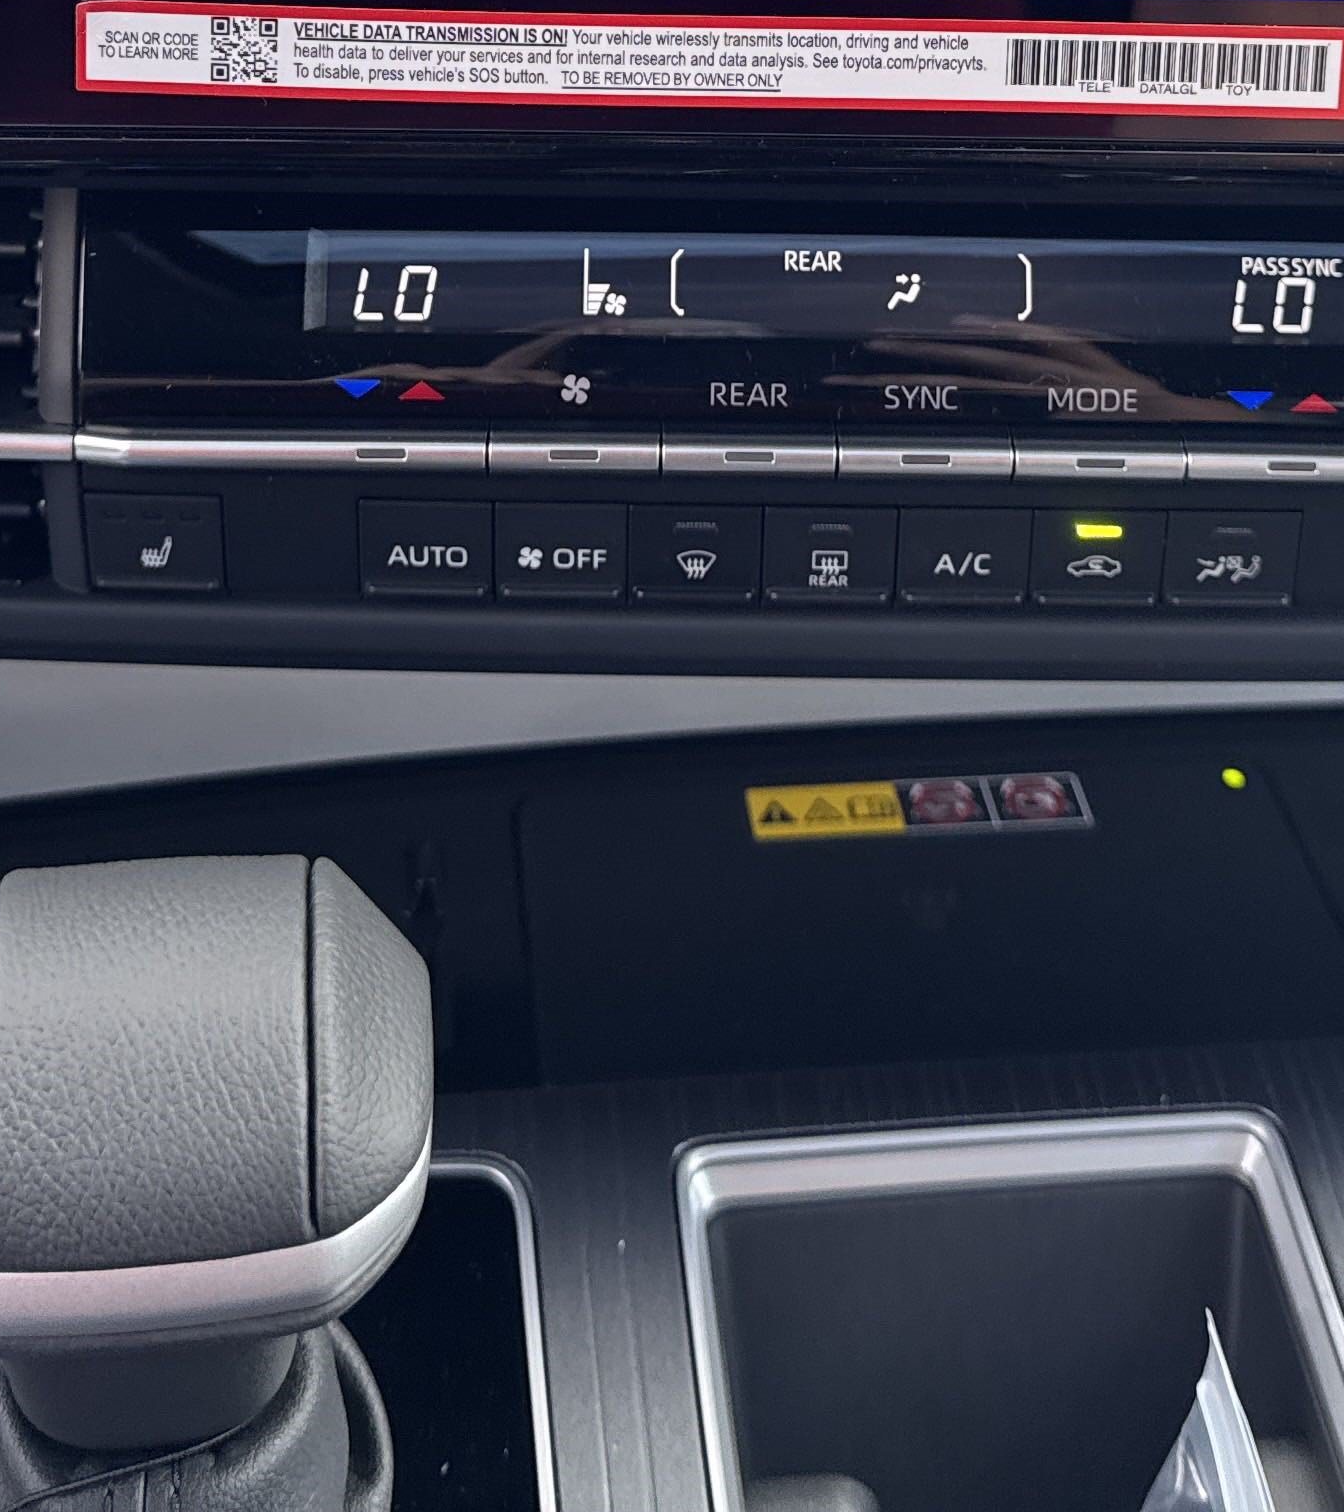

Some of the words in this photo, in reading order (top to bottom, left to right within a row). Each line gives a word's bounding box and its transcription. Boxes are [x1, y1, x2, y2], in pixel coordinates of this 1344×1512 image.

[105, 31, 139, 44] SCAN
[142, 32, 161, 45] QR
[163, 33, 199, 46] CODE
[294, 22, 359, 38] VEHICLE
[363, 24, 402, 39] DATA
[406, 25, 519, 43] TRANSMISSION
[523, 28, 537, 43] IS
[542, 28, 567, 44] ON!
[573, 29, 602, 45] Your
[606, 30, 651, 46] vehicle
[656, 30, 720, 50] wirelessly
[724, 31, 783, 48] transmits
[787, 33, 842, 50] location,
[846, 34, 888, 52] driving
[894, 34, 918, 49] and
[923, 35, 969, 50] vehicle
[99, 45, 116, 58] TO
[118, 45, 158, 60] LEARN
[163, 47, 199, 61] MORE
[294, 43, 333, 59] health
[338, 44, 367, 60] data
[372, 45, 384, 61] to
[389, 45, 432, 62] deliver
[437, 51, 466, 65] your
[469, 49, 523, 64] services
[528, 50, 551, 64] and
[556, 49, 573, 64] for
[577, 50, 625, 66] internal
[630, 51, 686, 67] research
[690, 52, 715, 67] and
[719, 52, 747, 67] data
[752, 53, 808, 71] analysis.
[812, 53, 839, 69] See
[294, 63, 309, 78] To
[313, 64, 364, 82] disable,
[368, 68, 404, 83] press
[409, 66, 465, 82] vehicle's
[469, 68, 500, 83] SOS
[505, 68, 548, 84] button.
[561, 71, 579, 85] TO
[583, 71, 600, 85] BE
[605, 72, 670, 86] REMOVED
[674, 72, 691, 86] BY
[694, 73, 744, 87] OWNER
[747, 73, 783, 88] ONLY
[1078, 81, 1112, 93] TELE
[1139, 83, 1197, 95] DATALGL
[1226, 84, 1253, 96] TOY
[784, 251, 842, 272] REAR
[1241, 256, 1290, 276] PASS
[1291, 257, 1344, 278] SYNC
[710, 383, 788, 408] REAR
[884, 386, 959, 410] SYNC
[1047, 387, 1138, 413] MODE
[388, 545, 468, 567] AUTO
[552, 547, 607, 569] OFF
[934, 552, 992, 576] A/C
[809, 574, 848, 586] REAR
